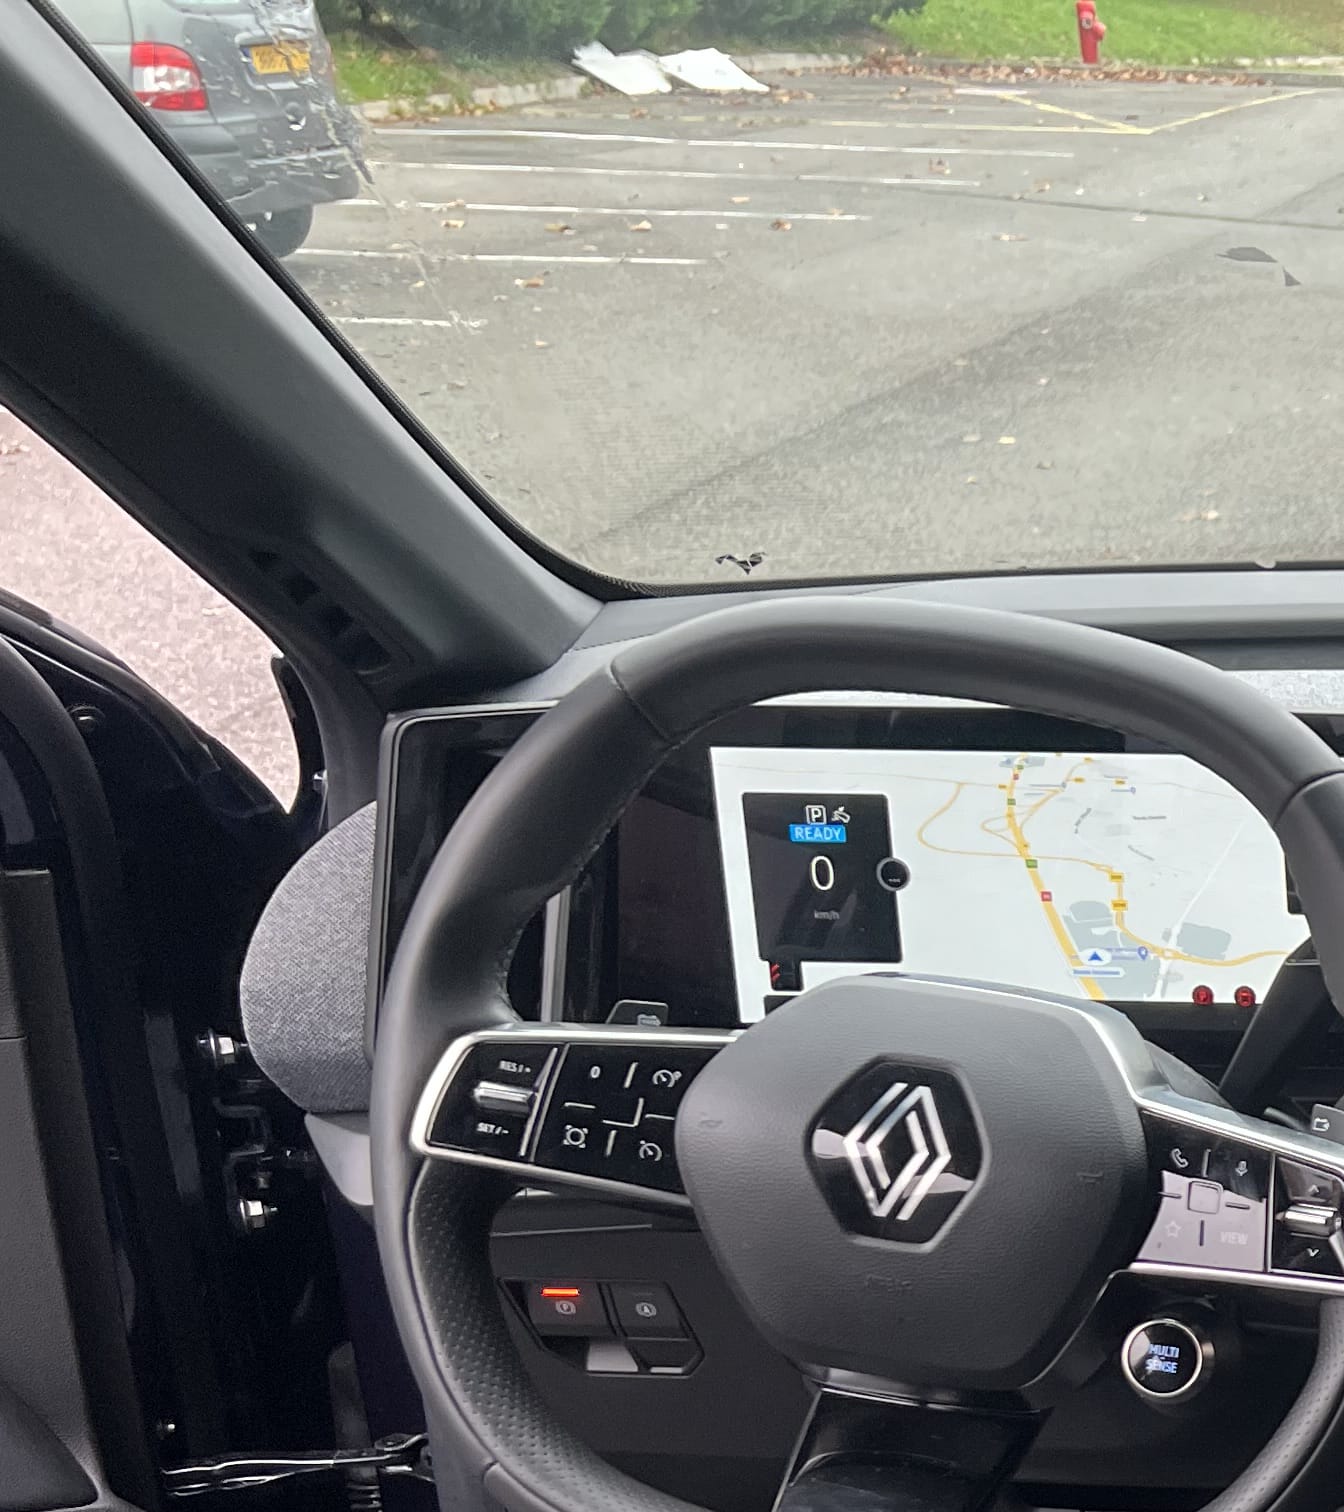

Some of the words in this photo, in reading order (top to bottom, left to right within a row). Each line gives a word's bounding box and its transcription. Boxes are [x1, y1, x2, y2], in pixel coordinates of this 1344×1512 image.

[794, 826, 841, 840] READY
[810, 856, 834, 890] 0
[1220, 1231, 1248, 1245] VIEW
[1148, 1343, 1180, 1358] MULTI
[1145, 1358, 1178, 1374] SENSE
